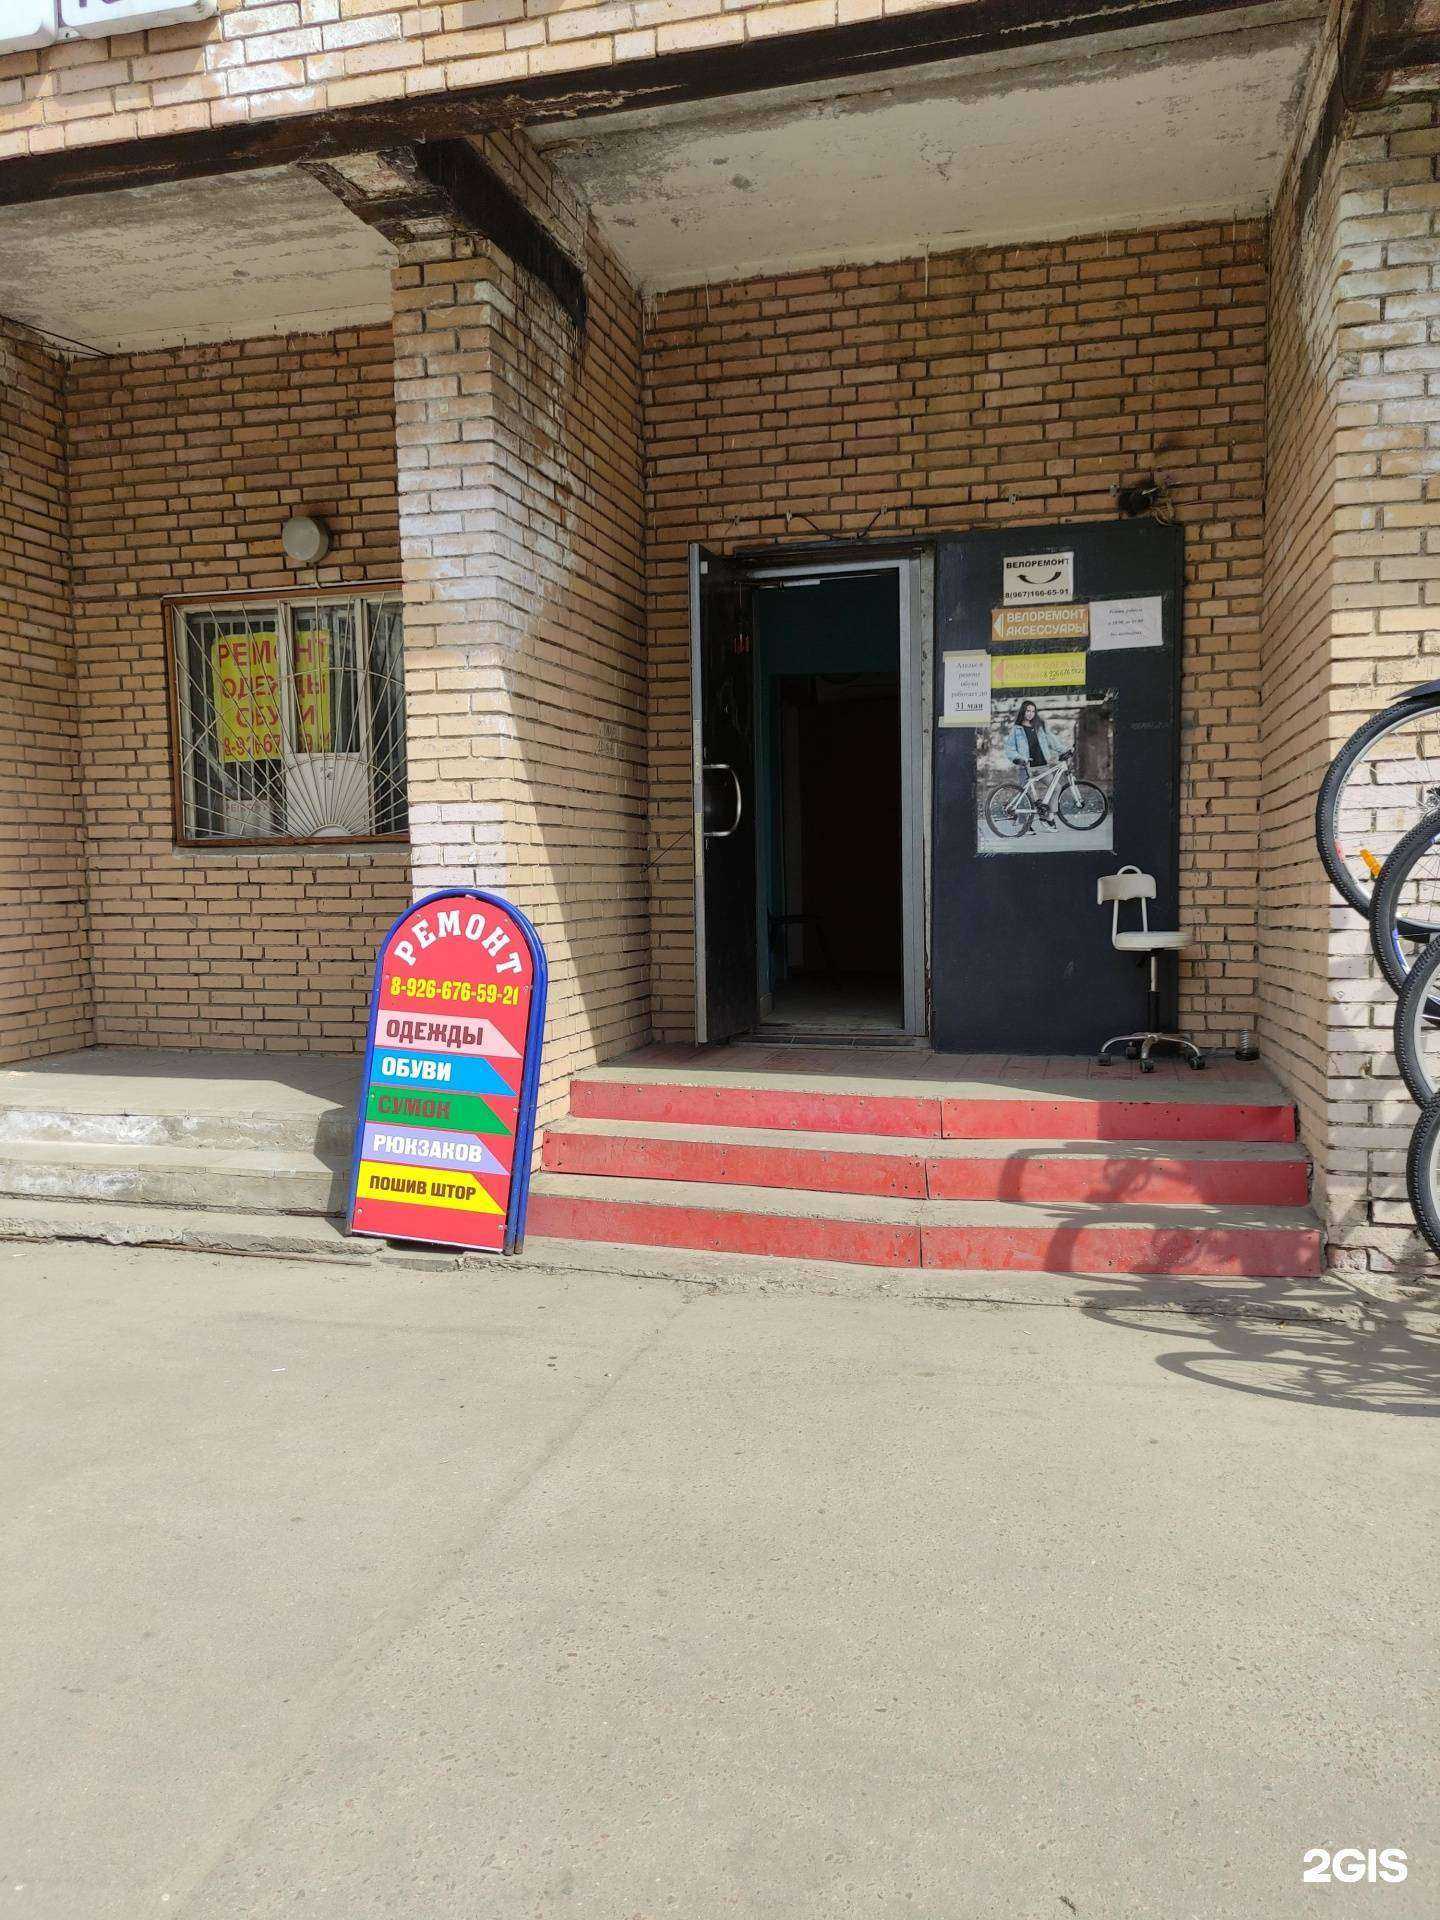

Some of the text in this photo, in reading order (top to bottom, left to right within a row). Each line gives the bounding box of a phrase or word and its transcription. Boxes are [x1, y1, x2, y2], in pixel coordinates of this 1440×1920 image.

[1006, 558, 1069, 569] ВЕЛОРЕМОНТ
[1007, 608, 1087, 623] ВЕЛОРЕМОНТ
[1006, 623, 1088, 637] АКСЕССУАРЫ
[218, 638, 327, 668] РЕМНТ
[394, 910, 523, 975] РЕМОНТ
[390, 976, 519, 1005] 8-926-676-59-21
[386, 1019, 483, 1048] ОДЕЖДЫ
[381, 1056, 452, 1082] ОБУВИ
[377, 1094, 450, 1120] СУМОК
[373, 1134, 482, 1163] РЮКЗАКОВ
[369, 1175, 476, 1200] ПОШИВ ШТОР
